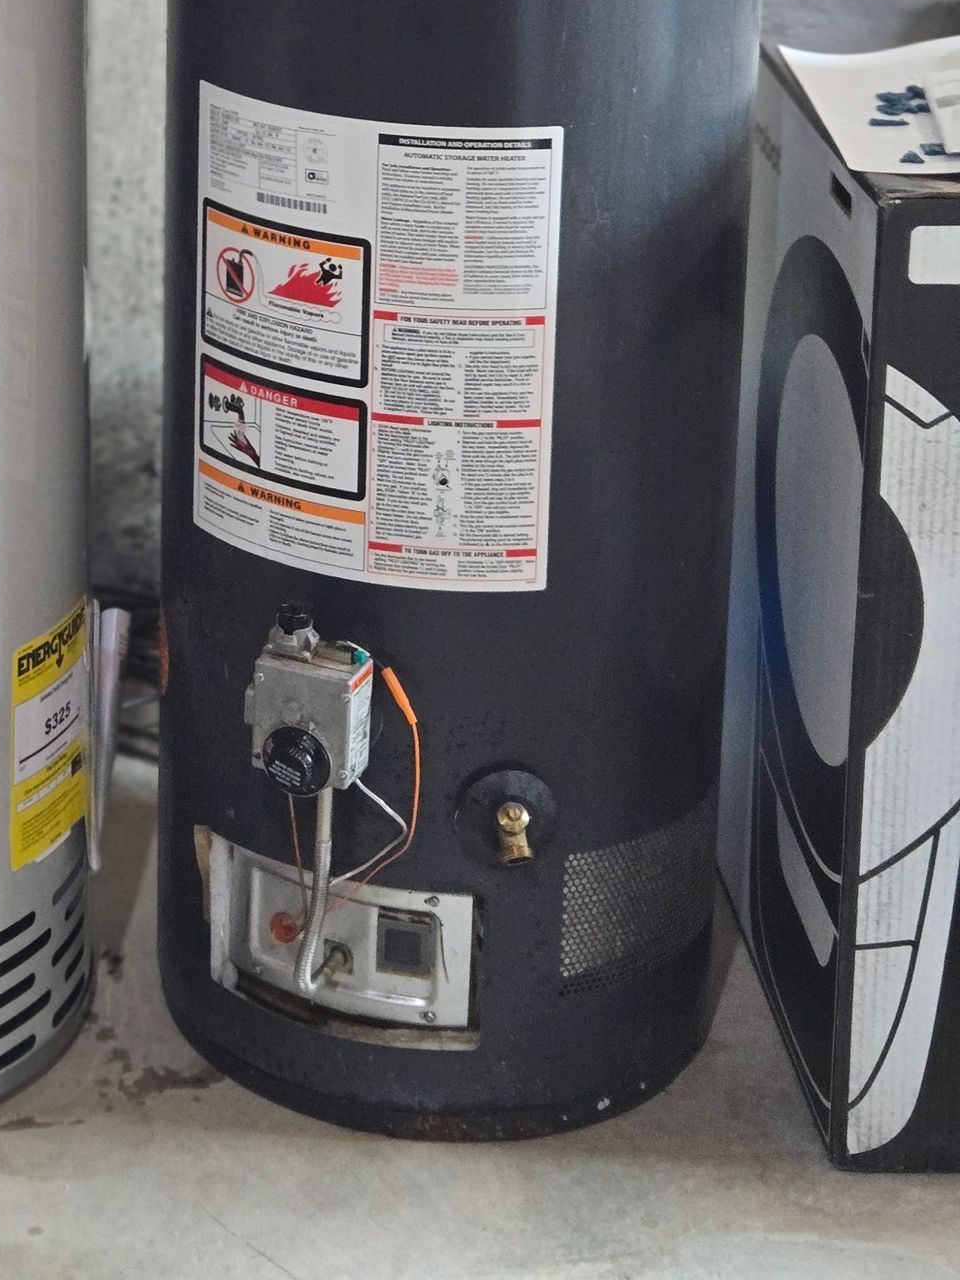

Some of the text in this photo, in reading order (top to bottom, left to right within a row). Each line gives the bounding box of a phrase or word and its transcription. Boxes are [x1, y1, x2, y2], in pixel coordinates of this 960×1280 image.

[404, 152, 443, 160] AUTOMATIC
[253, 226, 311, 250] WARNING
[268, 300, 324, 318] Flammable Vapors
[250, 385, 298, 408] DANGER
[250, 486, 302, 510] WARNING
